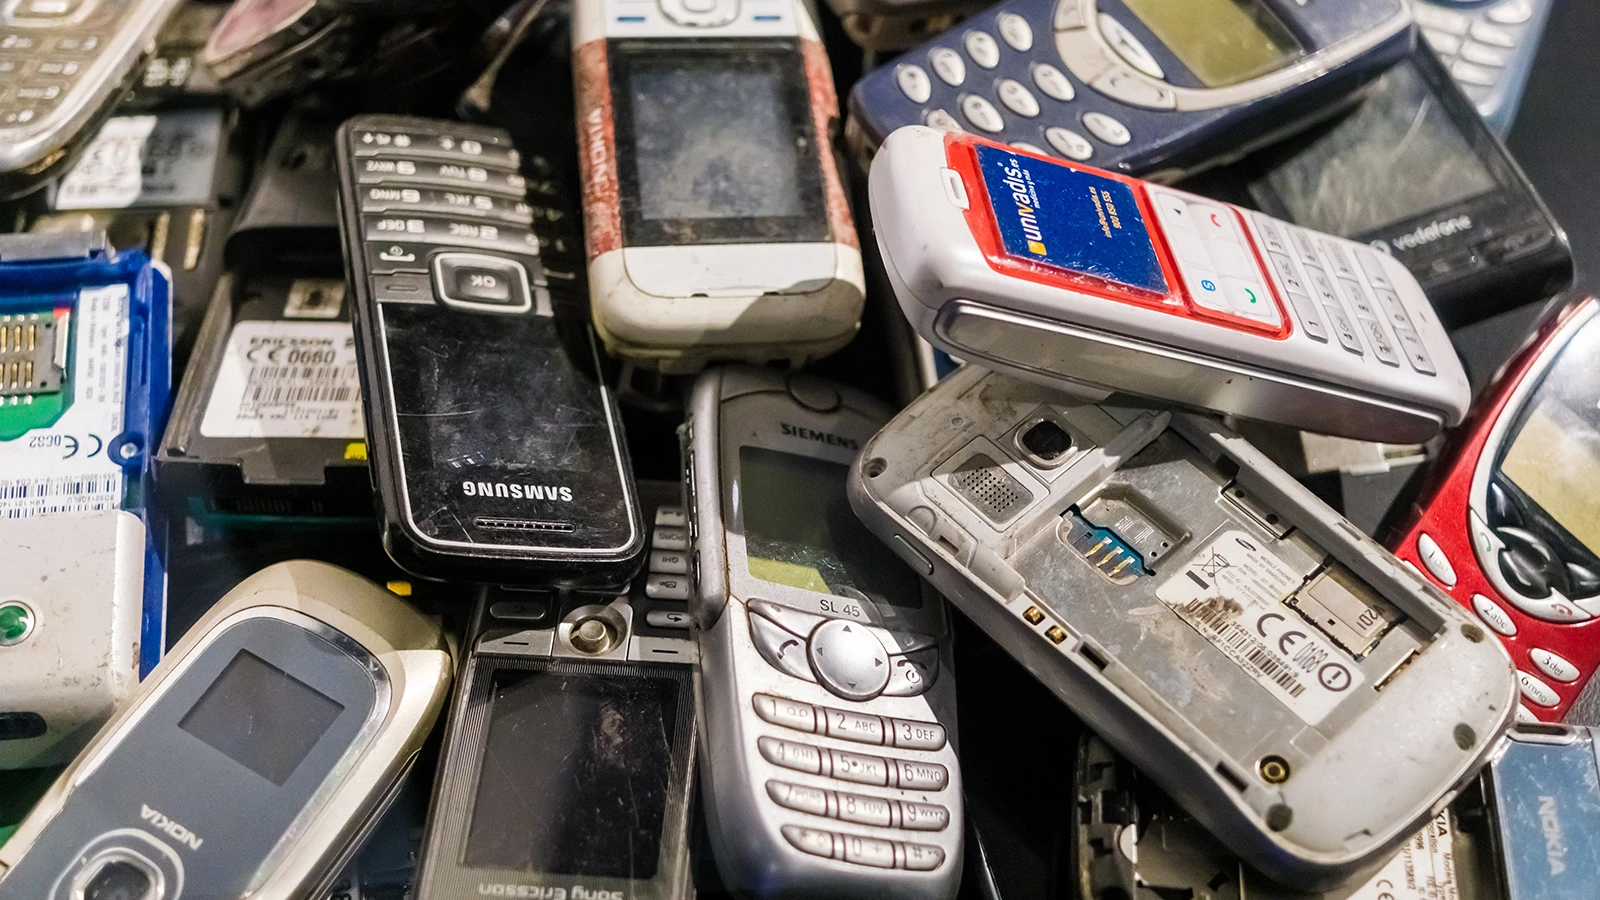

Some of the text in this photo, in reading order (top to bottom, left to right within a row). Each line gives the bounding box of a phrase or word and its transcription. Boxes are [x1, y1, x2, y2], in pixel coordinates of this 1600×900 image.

[587, 107, 608, 186] NOKIA
[1393, 215, 1473, 251] vodafone
[469, 272, 497, 289] OK
[780, 421, 860, 450] SIEMENS
[462, 481, 573, 502] SAMSUNG
[661, 556, 679, 564] GHI
[820, 599, 860, 618] SL 45
[1293, 641, 1329, 673] 0168
[836, 713, 876, 734] 2 ABC
[902, 723, 935, 742] 3 DEF
[904, 764, 942, 783] 6 MNO
[906, 803, 945, 822] 9 WXYZ
[140, 803, 203, 851] NOKIA
[1538, 795, 1566, 876] NOKIA
